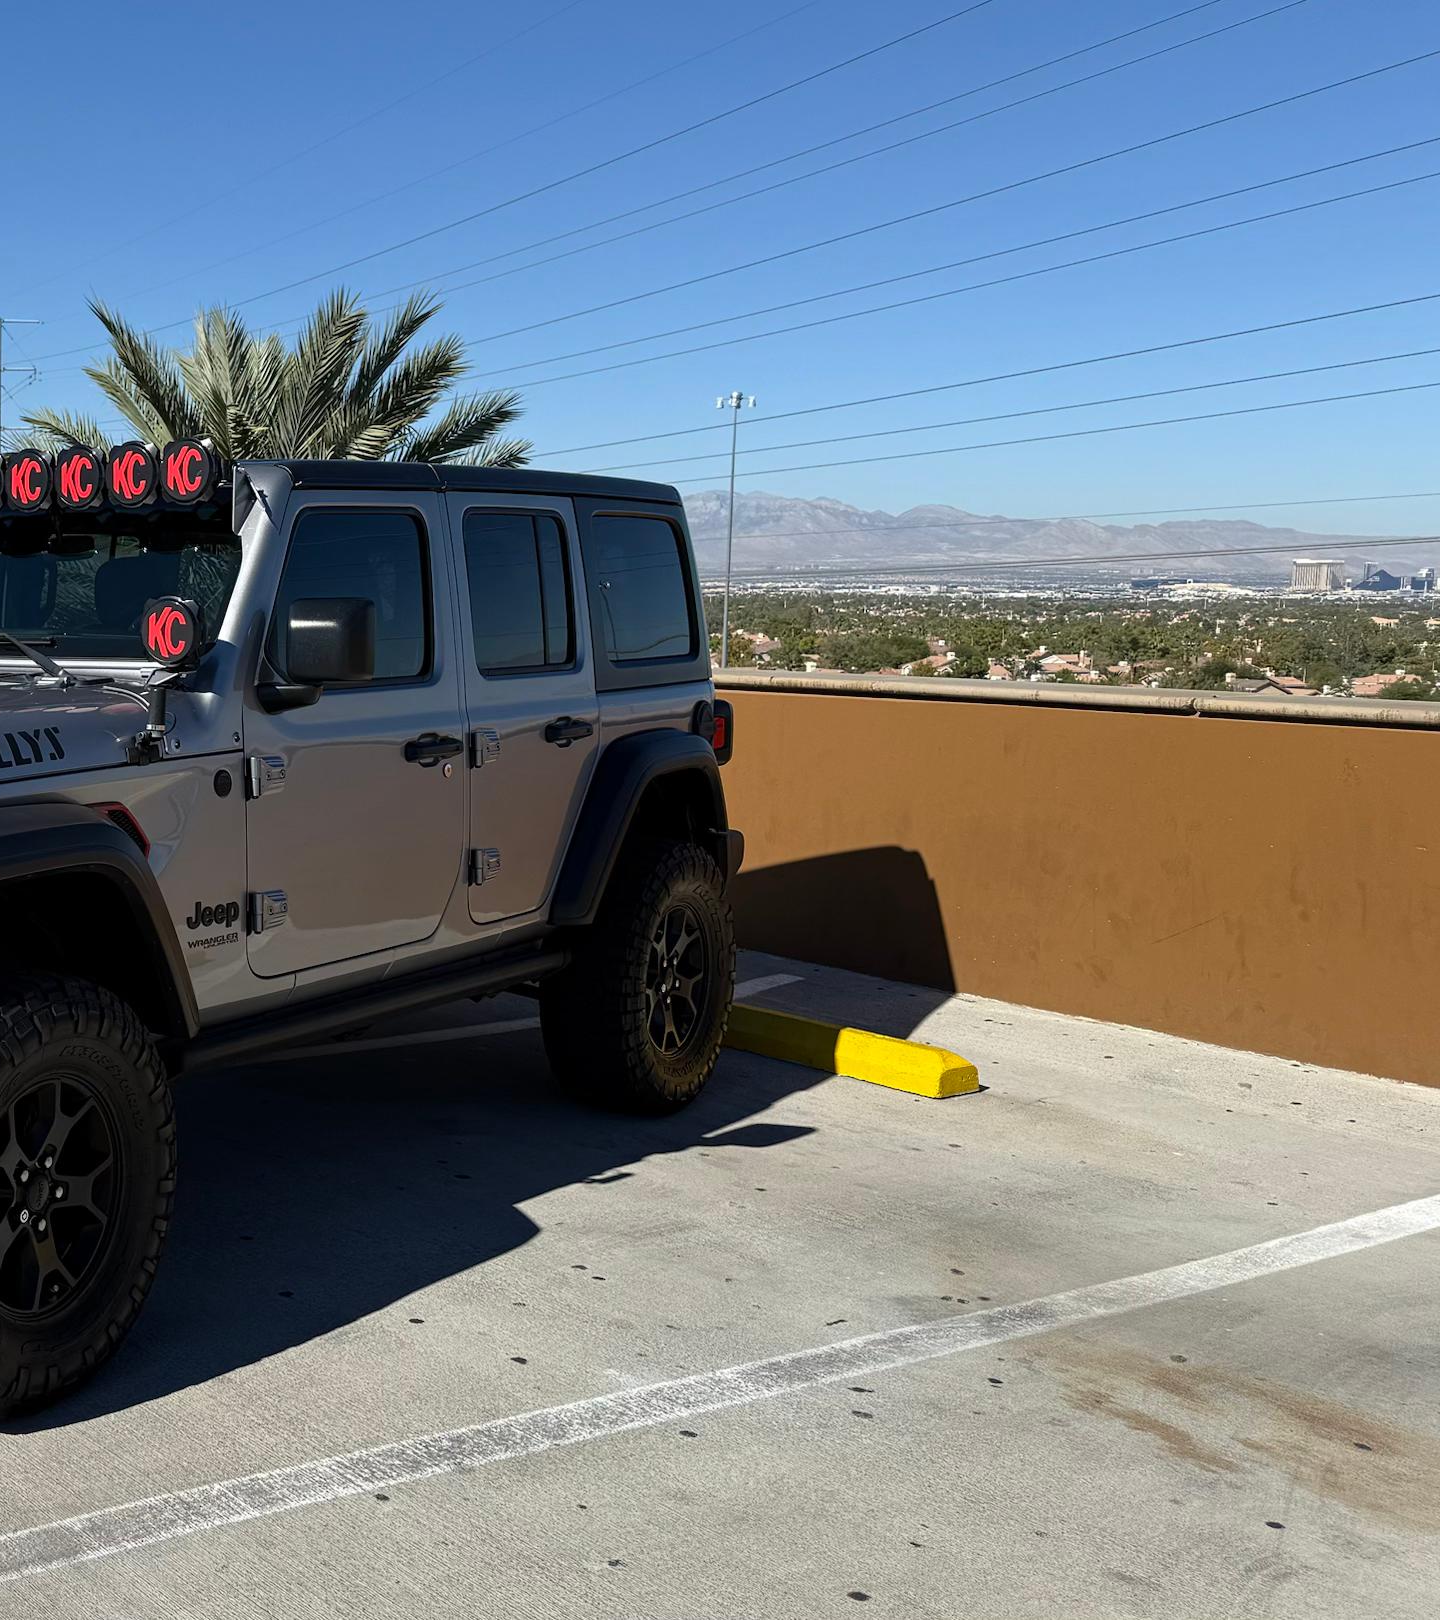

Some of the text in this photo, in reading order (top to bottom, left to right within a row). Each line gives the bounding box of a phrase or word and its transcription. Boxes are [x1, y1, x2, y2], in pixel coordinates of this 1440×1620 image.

[11, 458, 42, 504] KC
[60, 455, 93, 502] KC
[112, 450, 146, 499] KC
[166, 446, 203, 495] KC
[148, 606, 187, 658] KC
[186, 901, 240, 930] Jeep
[187, 932, 239, 949] WRANGLER
